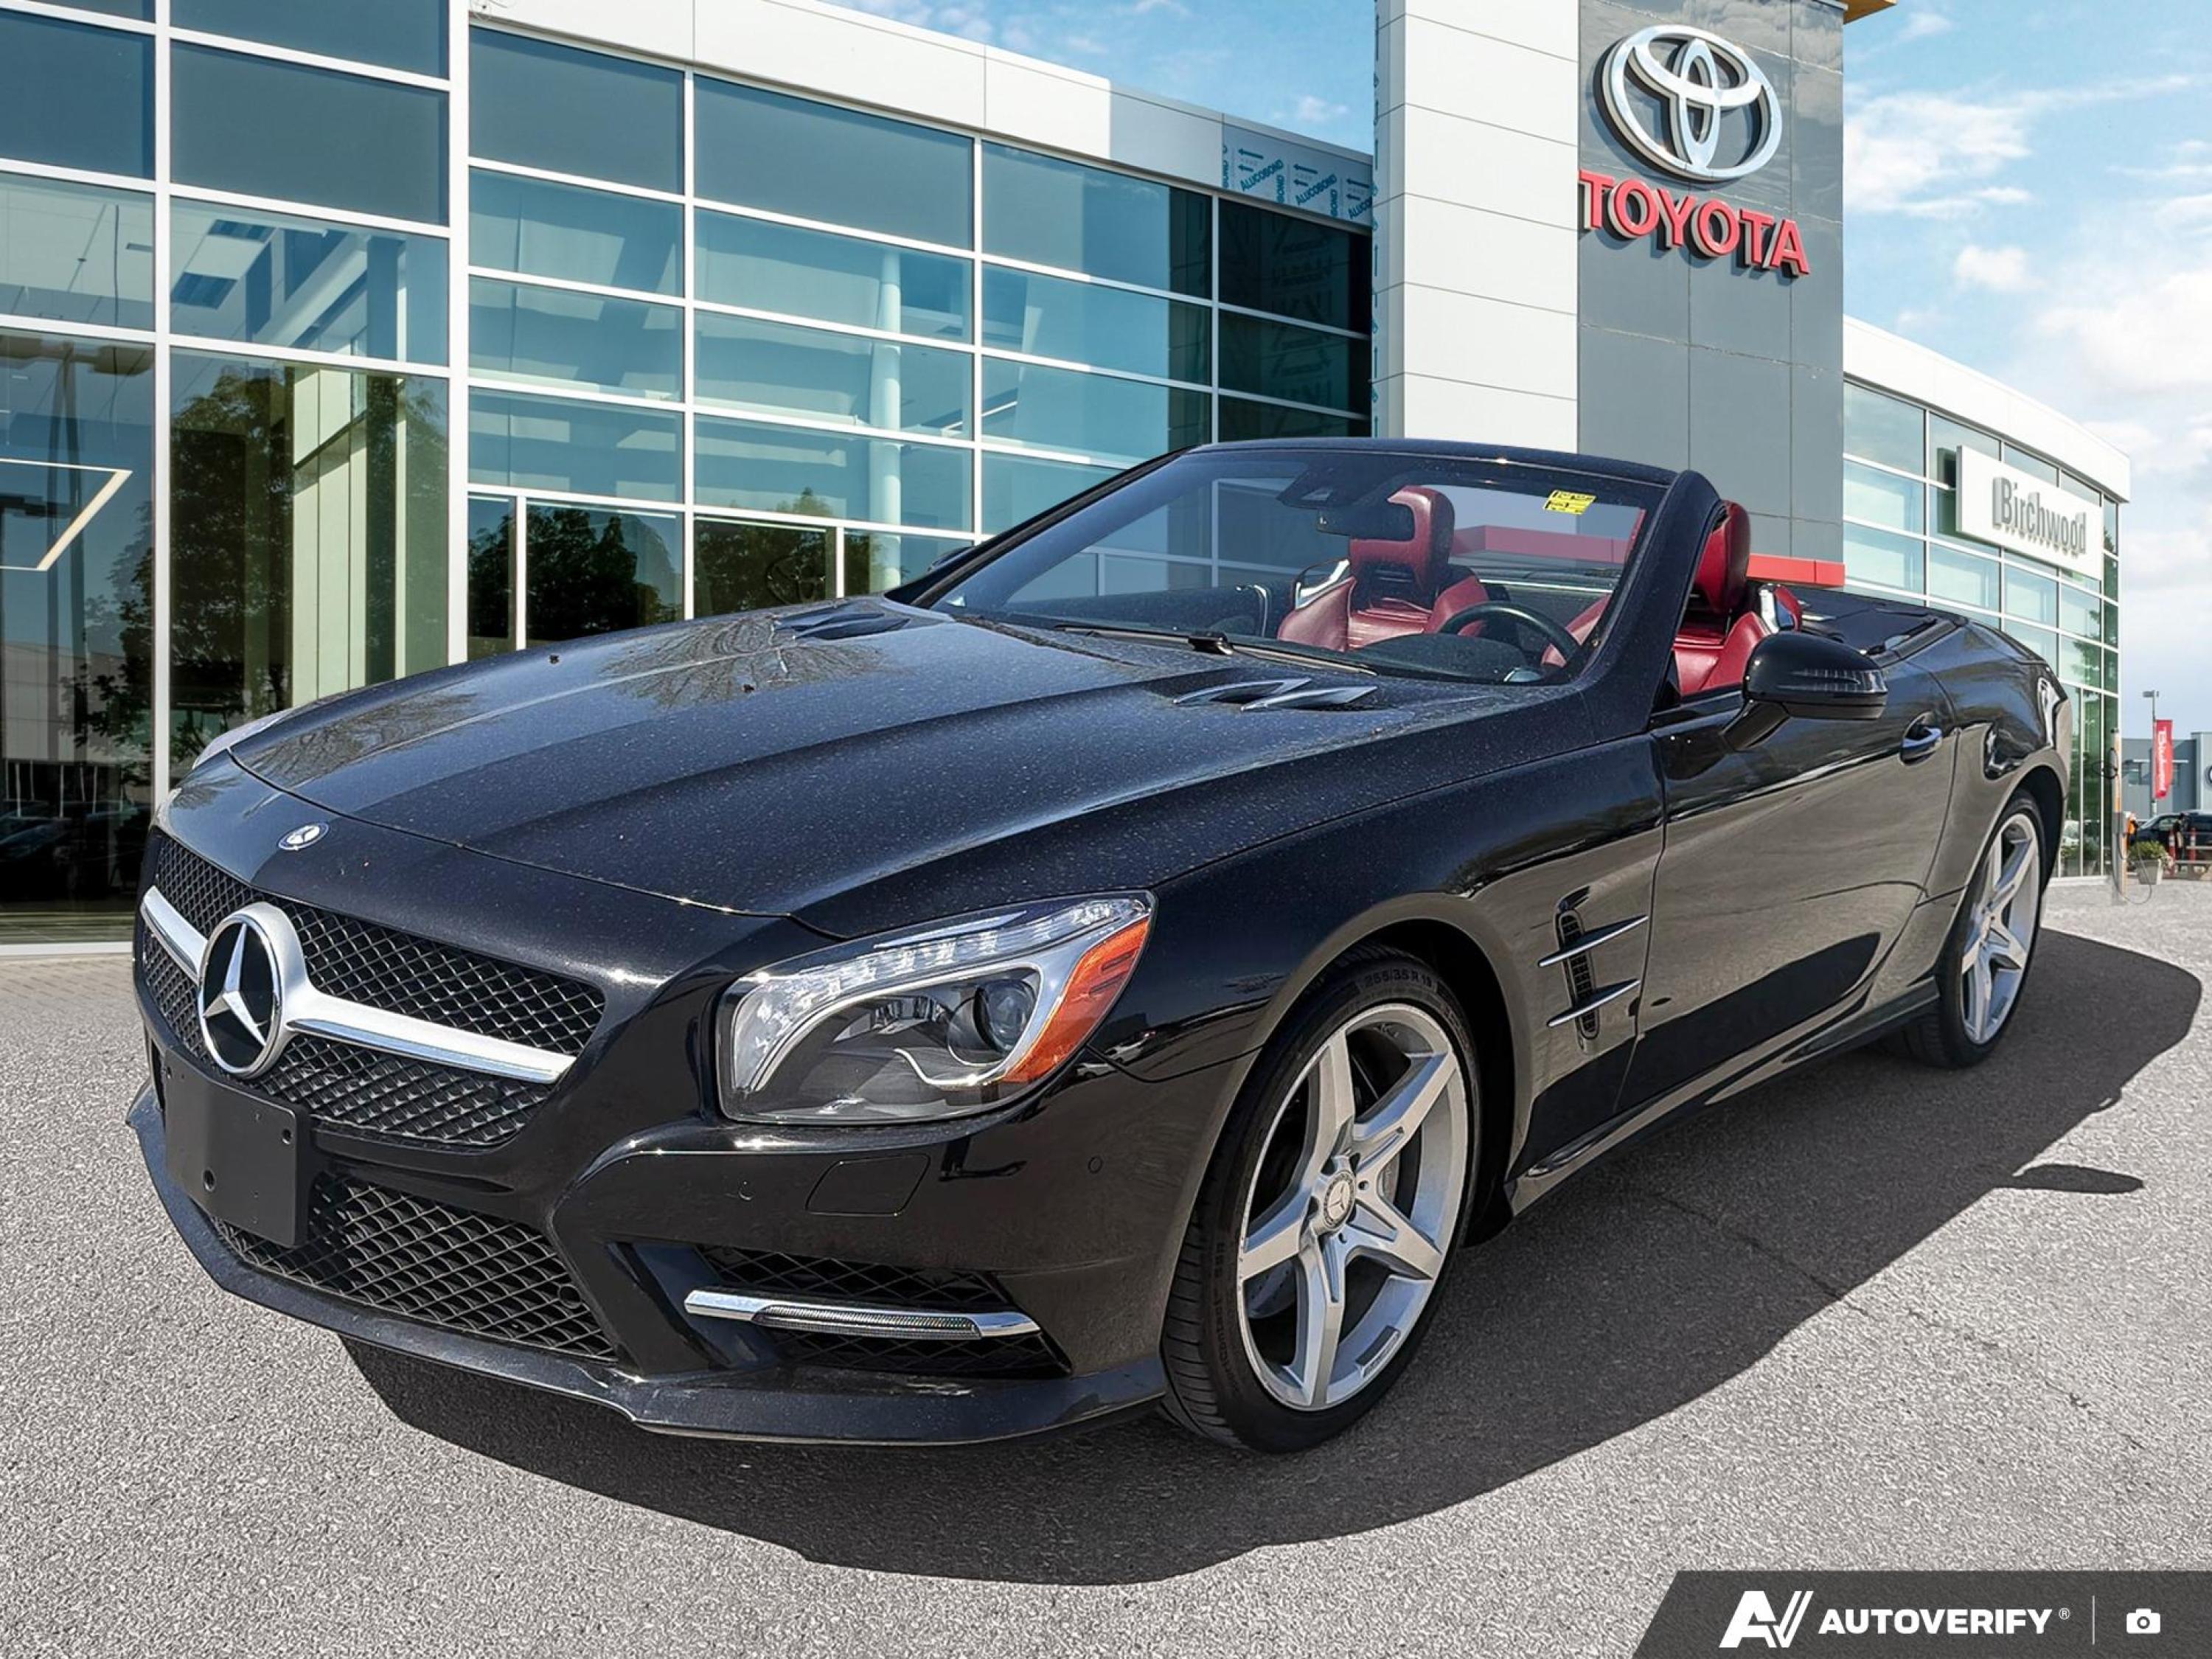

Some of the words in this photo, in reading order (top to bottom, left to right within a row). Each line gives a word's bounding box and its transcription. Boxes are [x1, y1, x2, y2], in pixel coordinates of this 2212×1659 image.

[1240, 159, 1284, 192] ALUCOBOND
[1295, 173, 1338, 206] ALUCOBOND
[1348, 196, 1373, 220] ALUCO
[1578, 168, 1809, 275] TOYOTA
[1997, 477, 2087, 555] Birchwood
